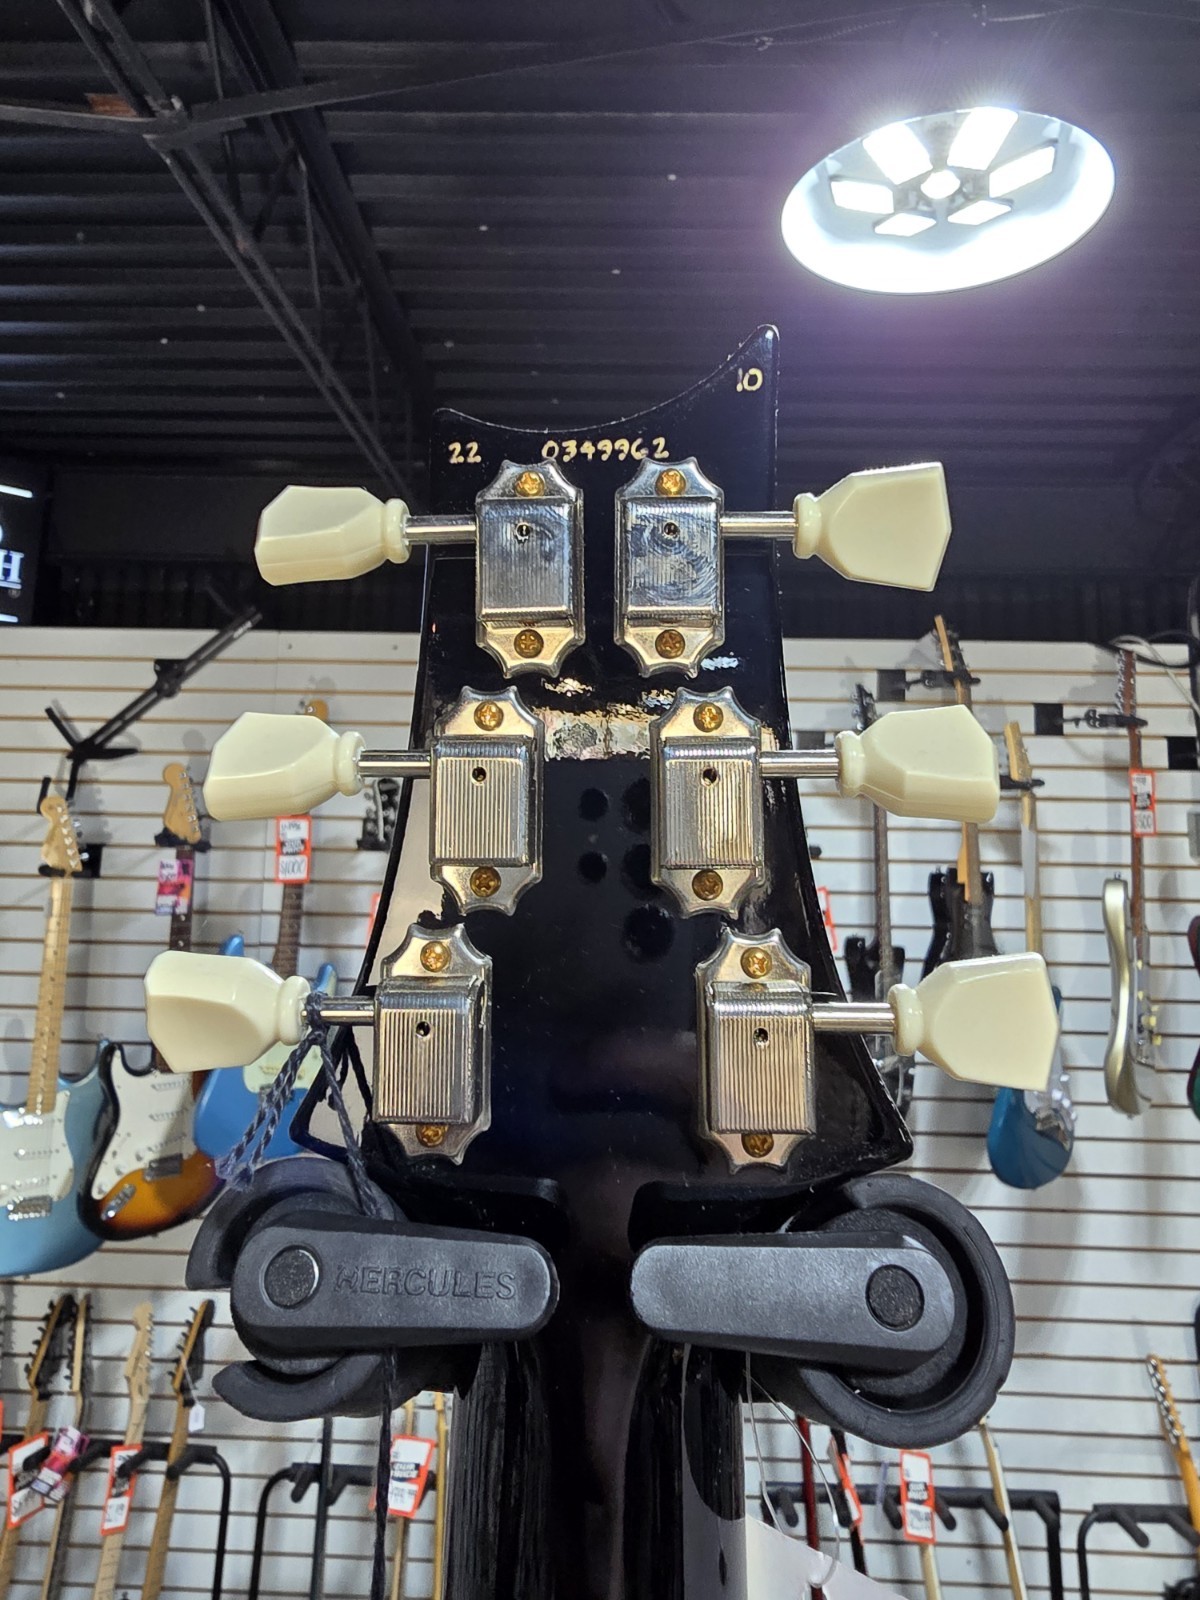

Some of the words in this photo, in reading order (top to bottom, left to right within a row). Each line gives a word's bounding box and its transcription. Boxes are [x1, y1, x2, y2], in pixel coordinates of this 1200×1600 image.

[736, 367, 763, 392] 10
[448, 441, 482, 464] 22
[541, 437, 670, 462] 0349962
[333, 1264, 517, 1300] HERCULES
